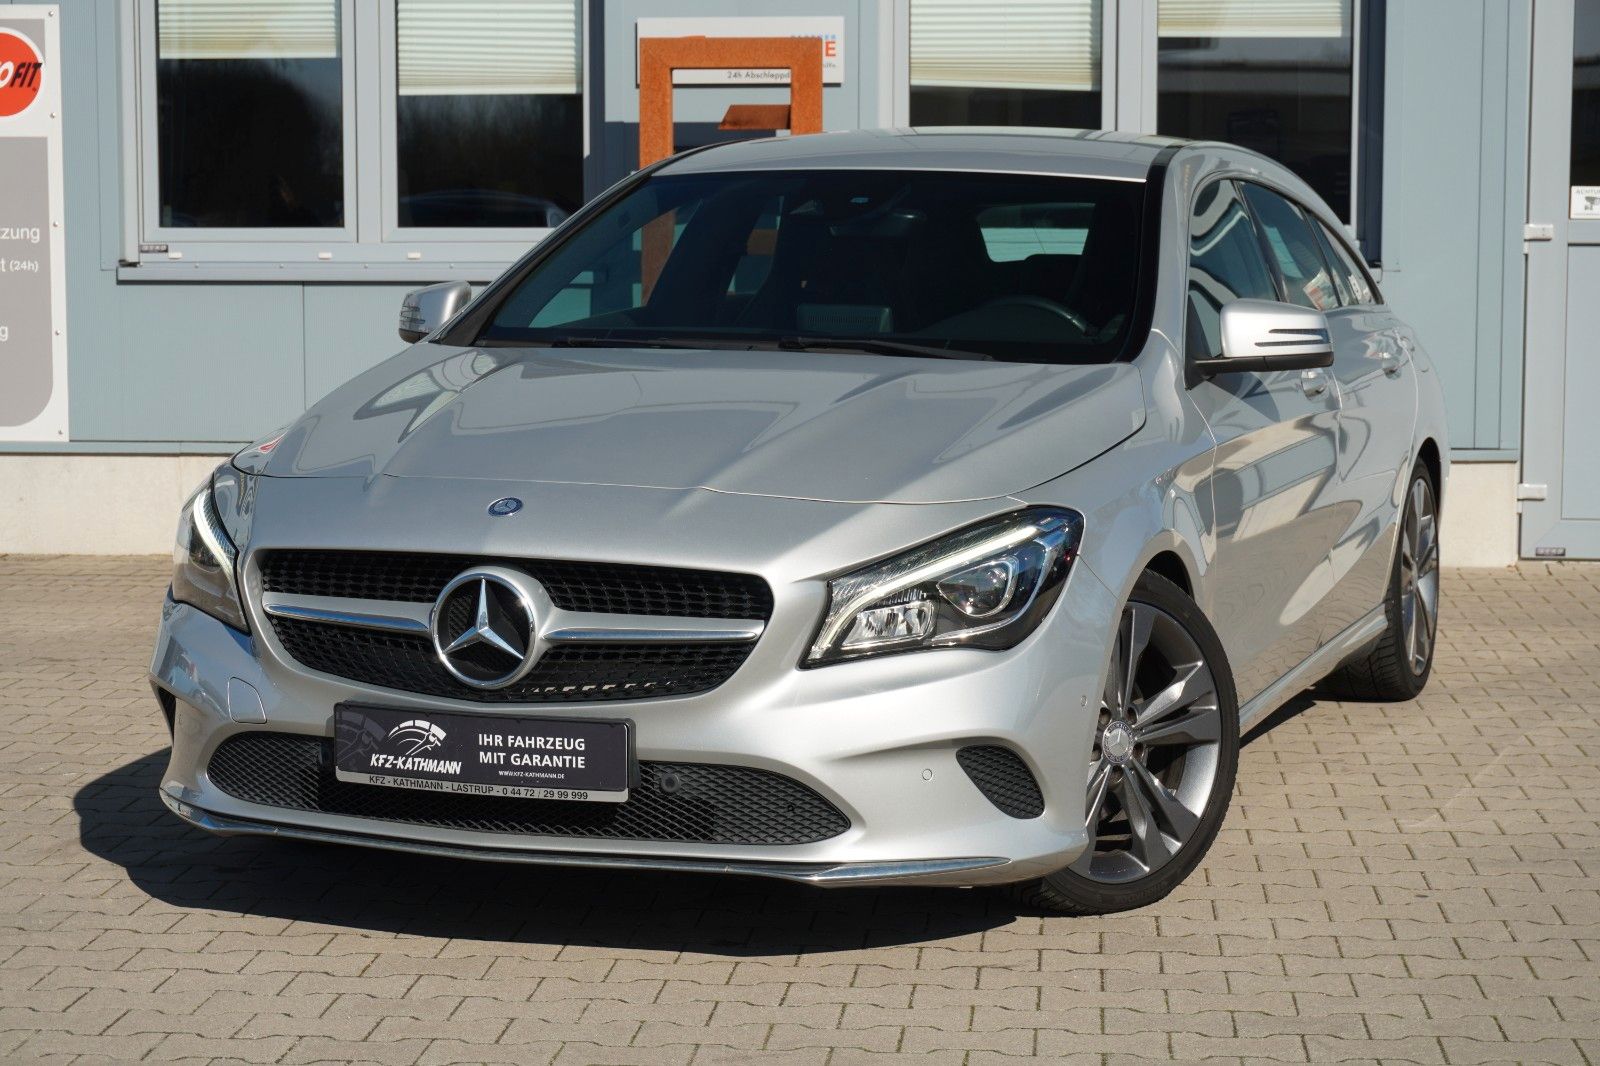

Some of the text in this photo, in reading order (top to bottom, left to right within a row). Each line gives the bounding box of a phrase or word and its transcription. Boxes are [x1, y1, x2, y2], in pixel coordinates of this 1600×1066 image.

[727, 71, 791, 80] 24h Abschleppd
[9, 260, 39, 272] (24h)
[478, 733, 585, 750] IHR FAHRZEUG
[370, 753, 462, 775] KFZ-KATHMANN
[479, 751, 586, 768] MIT GARANTIE
[498, 770, 565, 779] WWW.KFZ-KATHMANN.DE
[369, 775, 386, 785] KFZ
[393, 777, 443, 790] KATHMANN
[451, 783, 494, 794] LASTRUP
[502, 787, 508, 795] 0
[510, 788, 521, 796] 44
[523, 788, 535, 797] 72
[543, 790, 555, 798] 29
[557, 790, 569, 799] 99
[571, 792, 588, 800] 999
